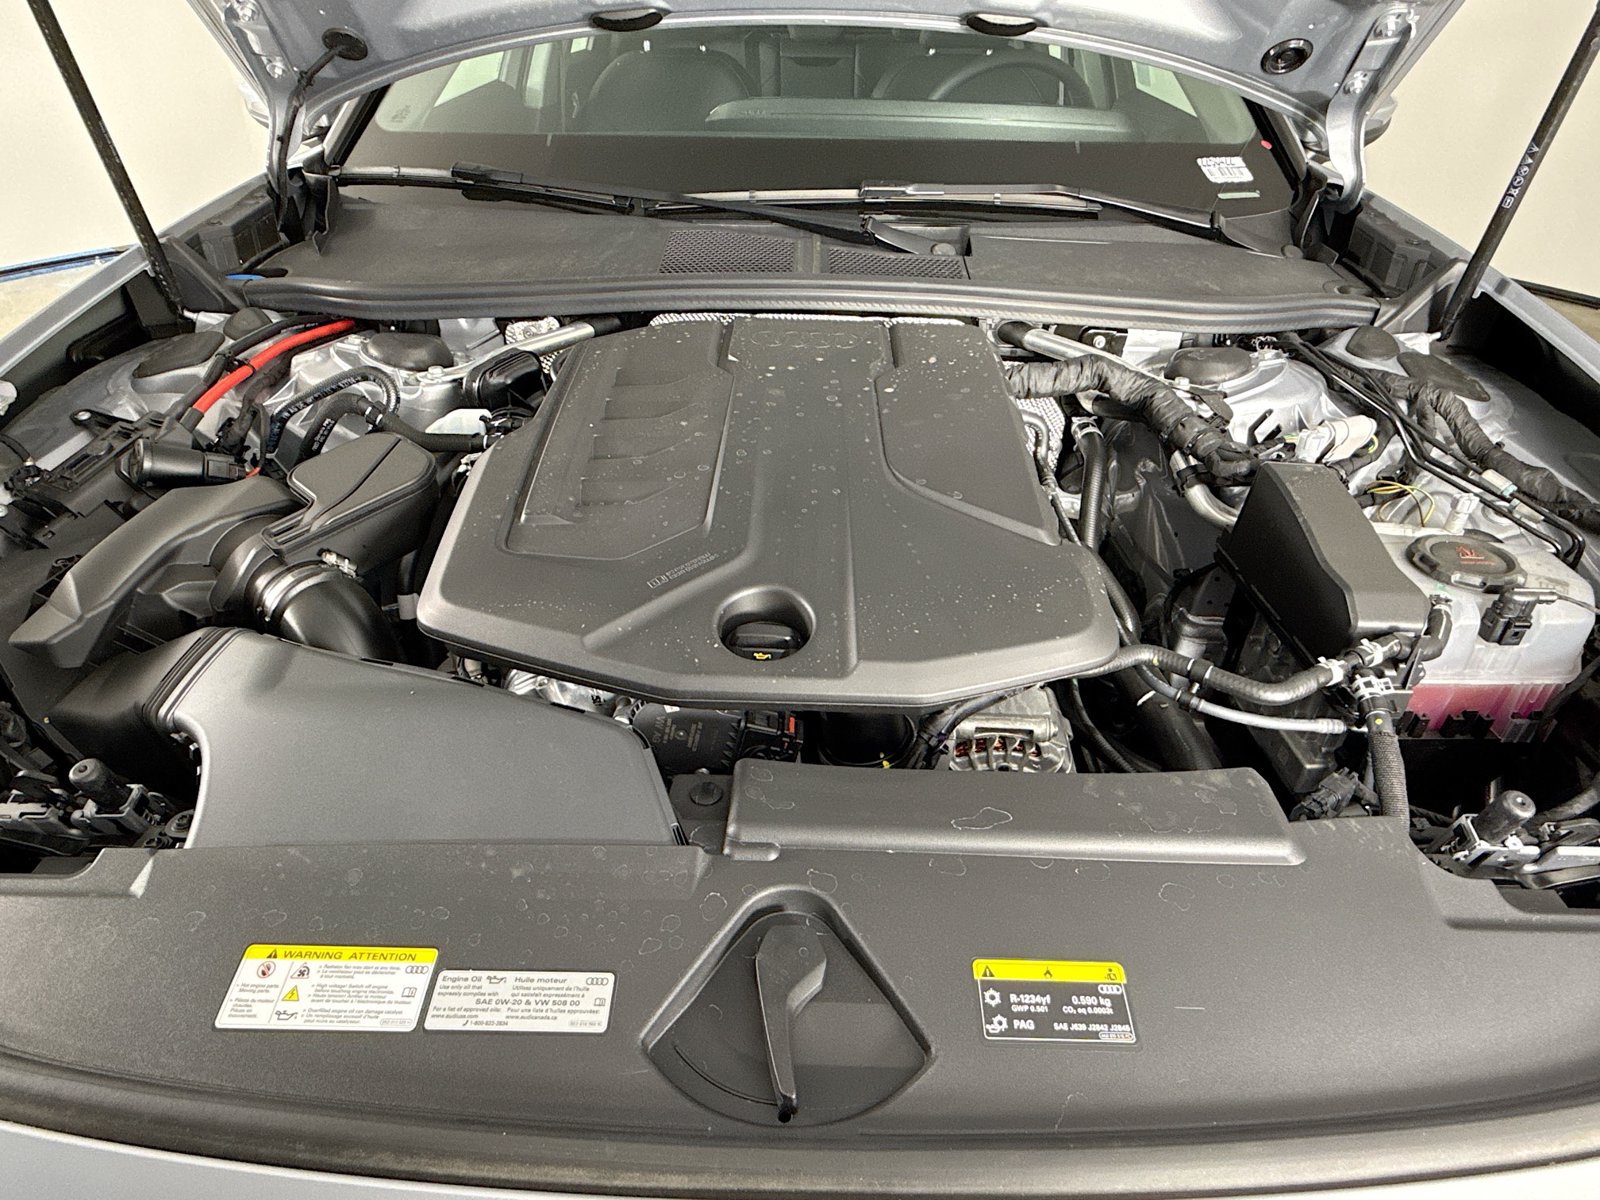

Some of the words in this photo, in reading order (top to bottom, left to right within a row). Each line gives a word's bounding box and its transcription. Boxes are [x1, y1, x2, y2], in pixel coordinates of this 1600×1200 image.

[283, 950, 342, 960] WARNING
[348, 952, 417, 961] ATTENTION
[1009, 994, 1051, 1006] R-1234yf
[1071, 995, 1098, 1006] 0.590
[1098, 996, 1112, 1008] kg
[1013, 1020, 1036, 1030] PAG
[1053, 1022, 1069, 1031] SAE
